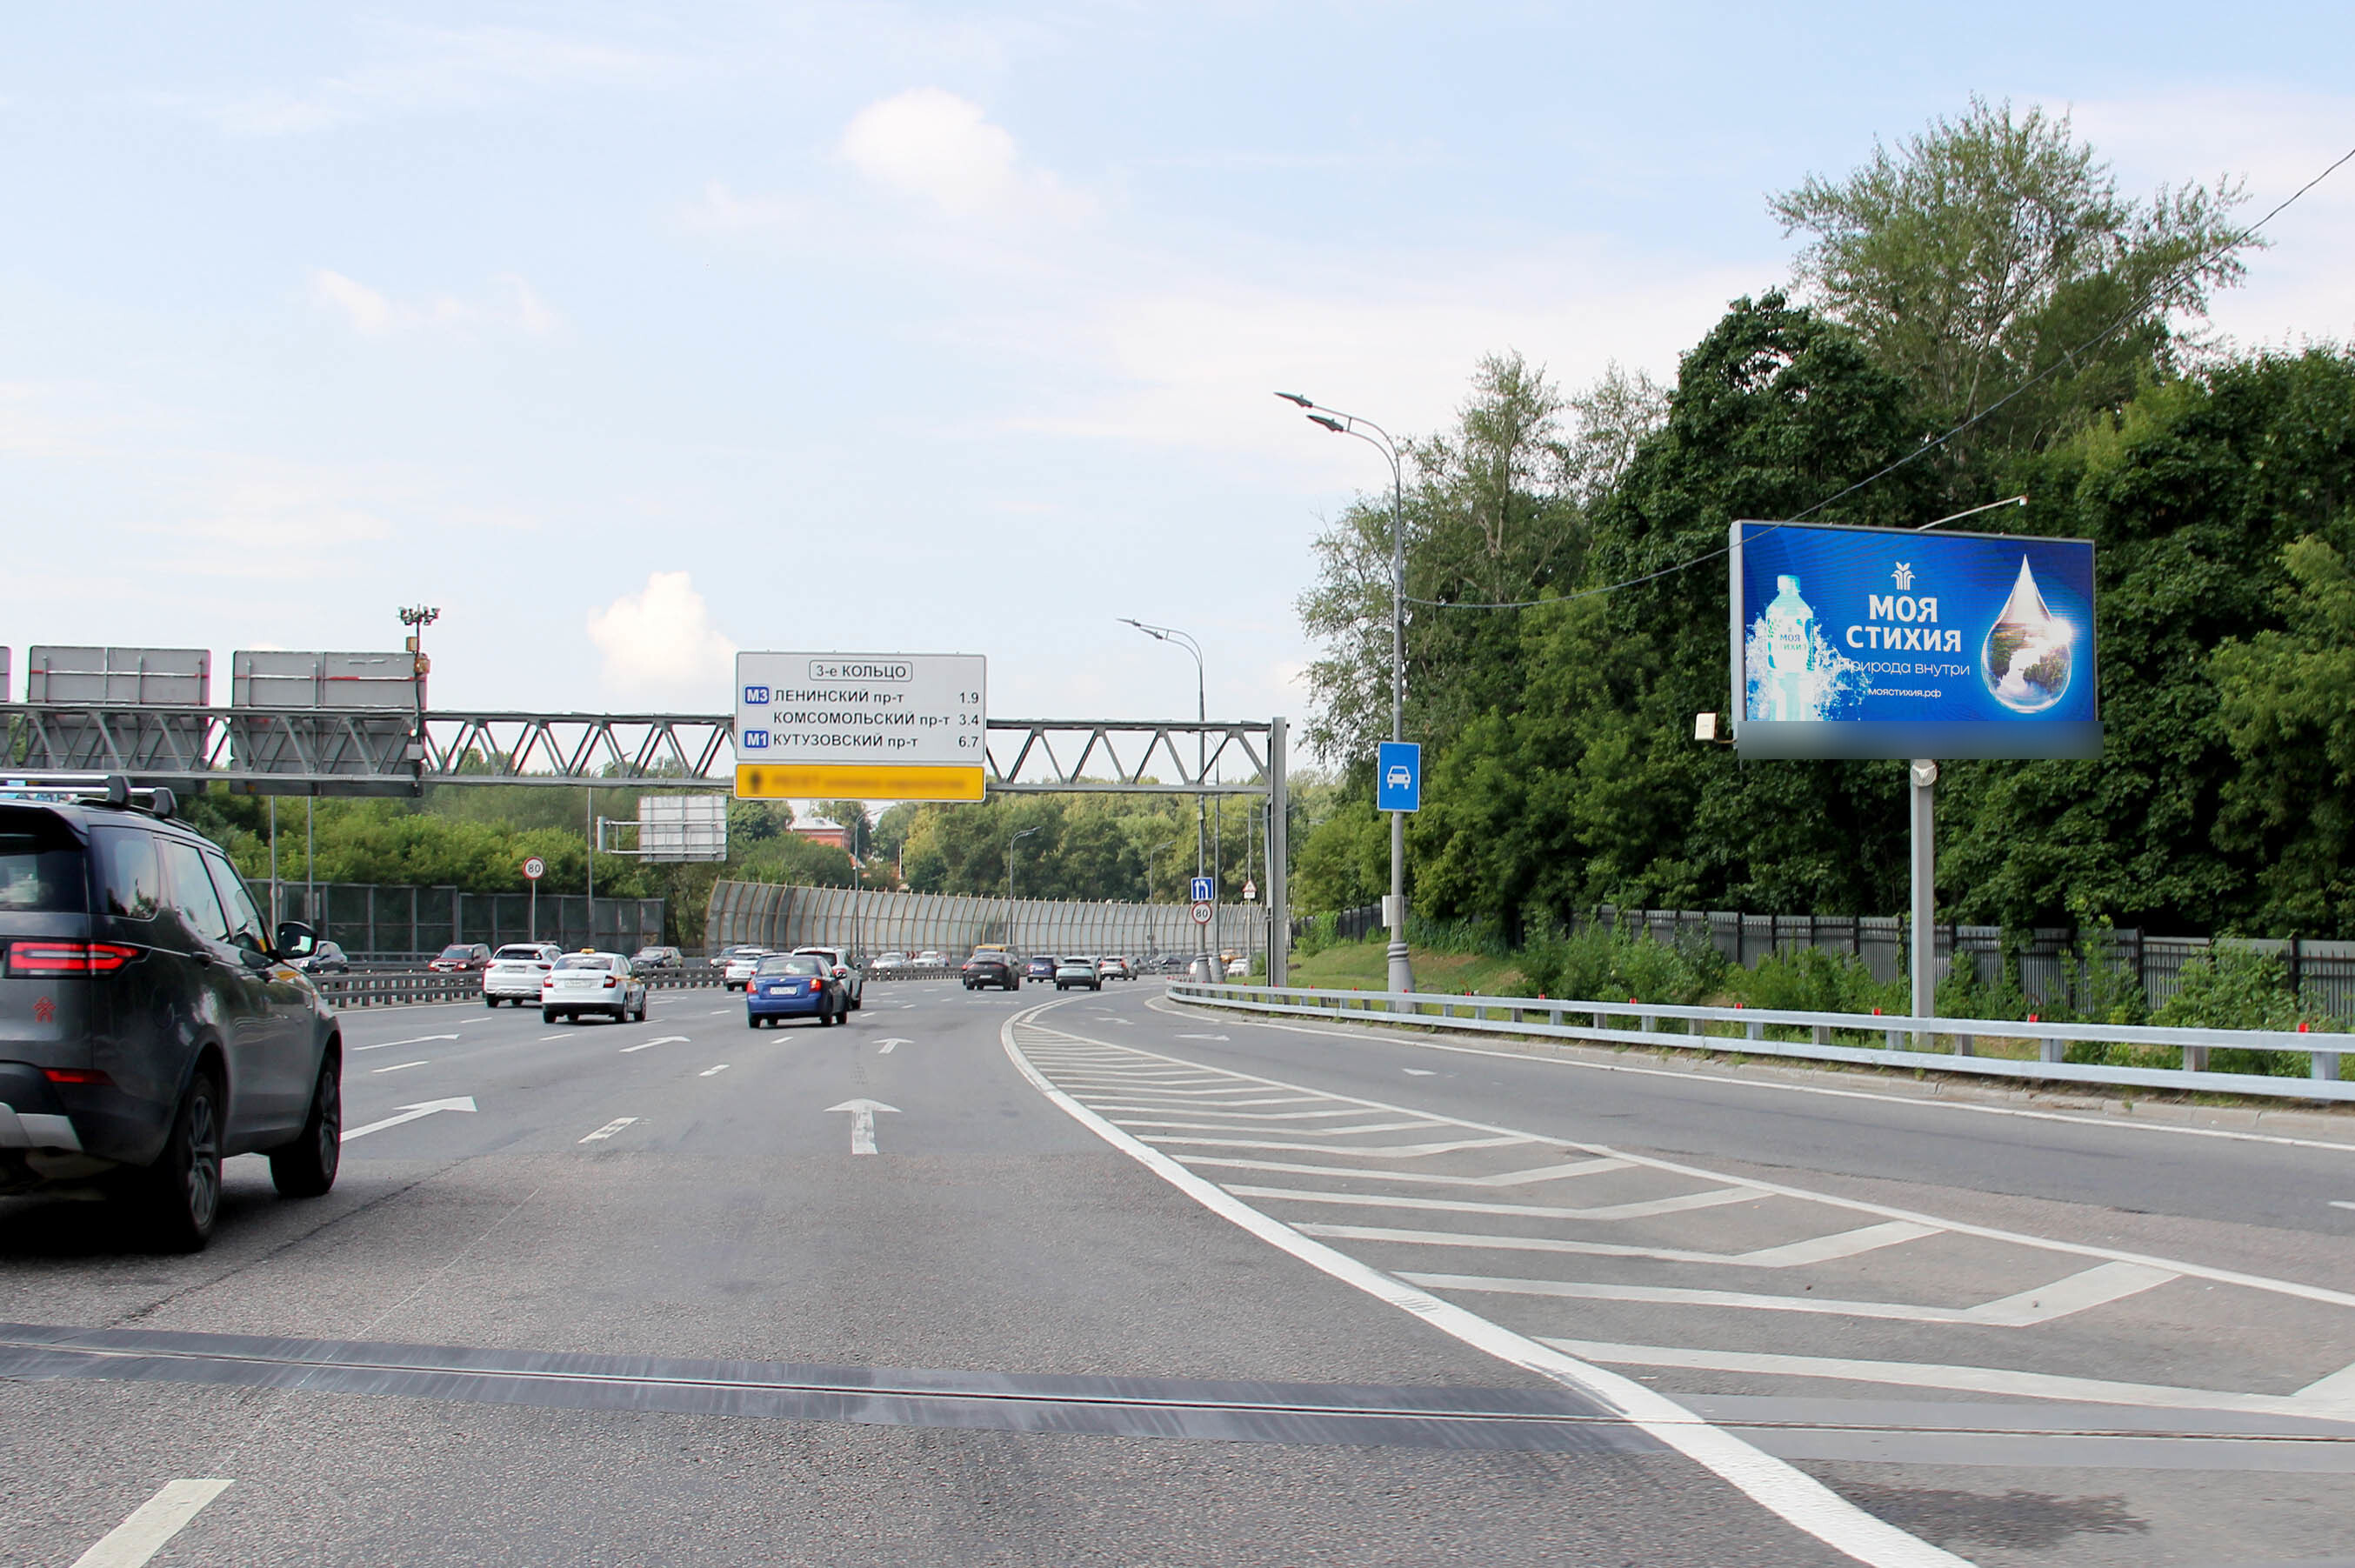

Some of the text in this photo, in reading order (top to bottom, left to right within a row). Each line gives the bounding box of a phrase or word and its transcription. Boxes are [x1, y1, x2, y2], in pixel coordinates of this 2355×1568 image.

[1868, 595, 1938, 623] МОЯ
[1845, 624, 1962, 652] СТИХИЯ
[816, 664, 906, 678] 3-е КОЛЬЦО
[1841, 660, 1971, 677] рирода внутри
[746, 688, 979, 705] М3 ЛЕНИНСКИЙ пр-т 1.9
[1868, 688, 1942, 698] моястихия.рф
[773, 710, 979, 729] КОМСОМОЛЬСКИЙ пр-т 3.4
[746, 732, 979, 750] М1 КУТУЗОВСКИЙ пр-т 6.7
[528, 864, 541, 873] 80
[1196, 908, 1208, 918] 80
